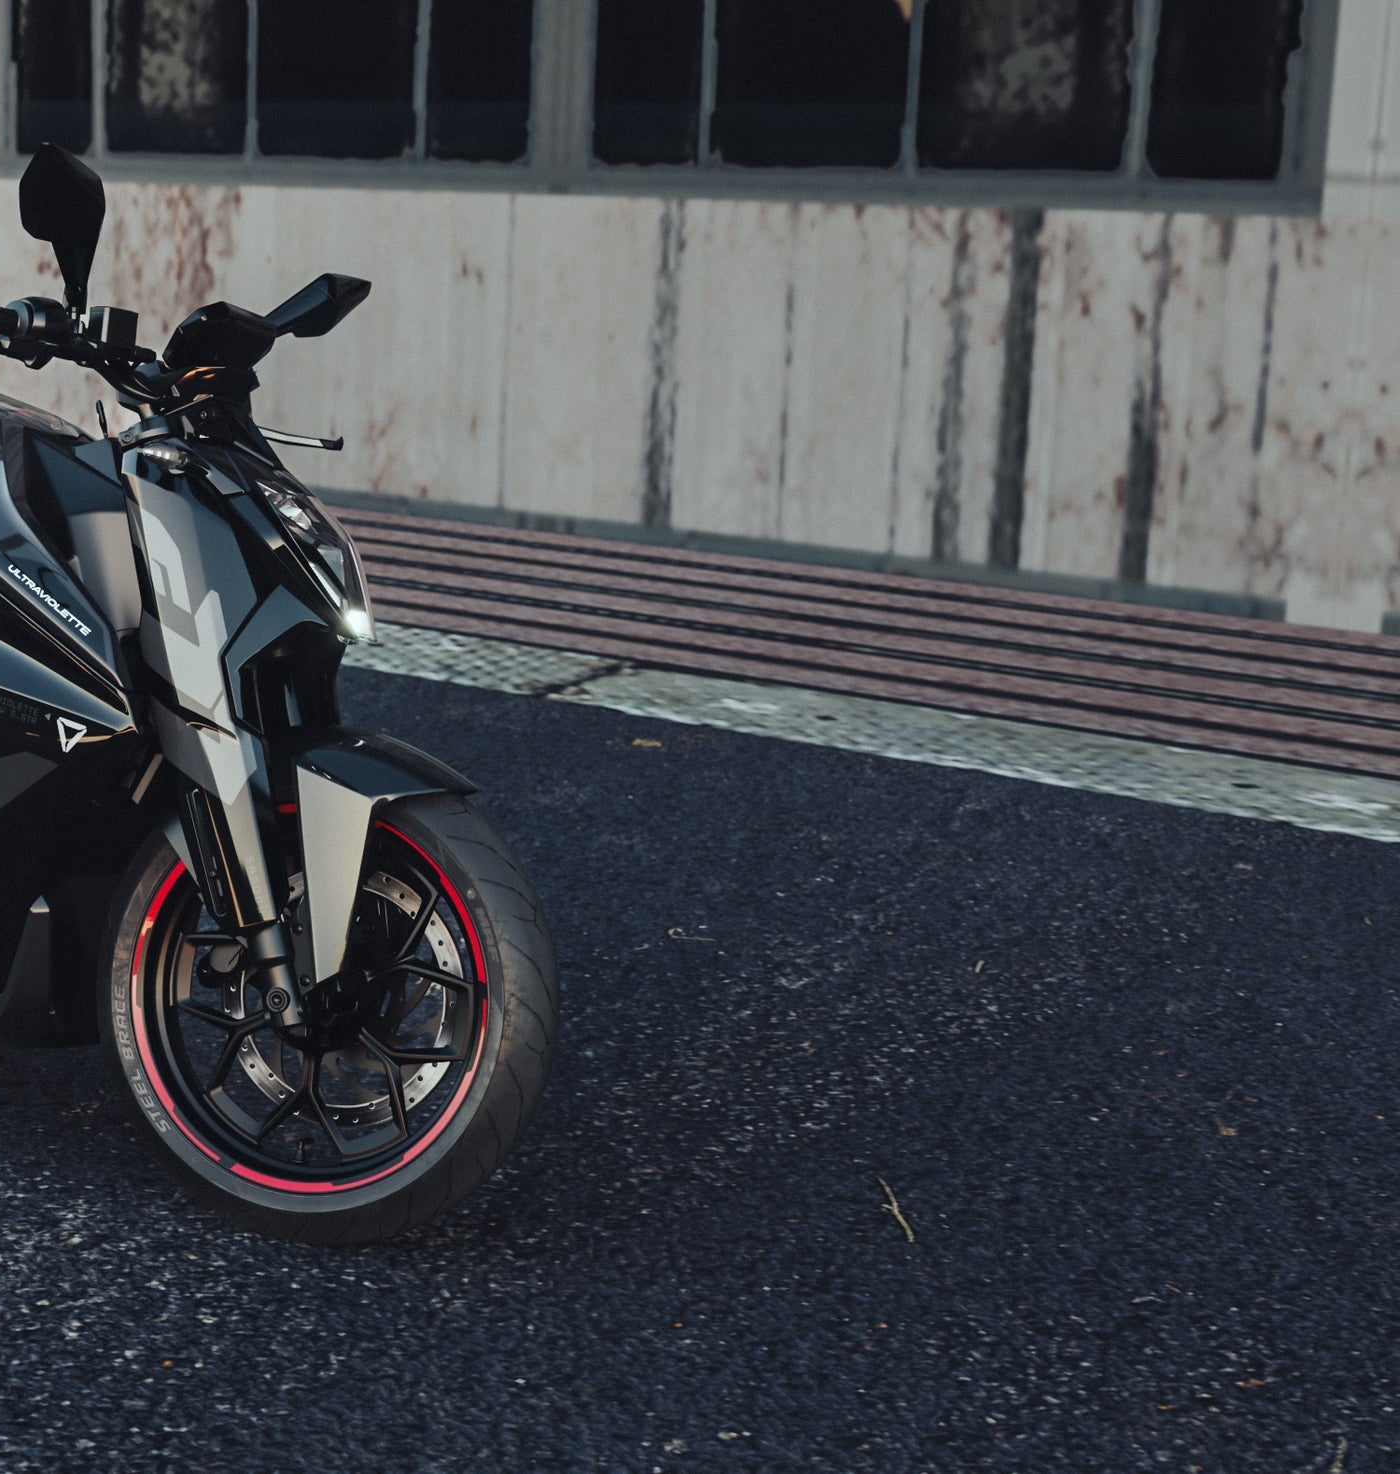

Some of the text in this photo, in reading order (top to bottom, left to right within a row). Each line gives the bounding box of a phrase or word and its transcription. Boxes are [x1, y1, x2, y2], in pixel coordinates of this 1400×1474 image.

[7, 564, 92, 636] ULTRAVIOLETTE
[114, 986, 173, 1133] STEEL BRACE
